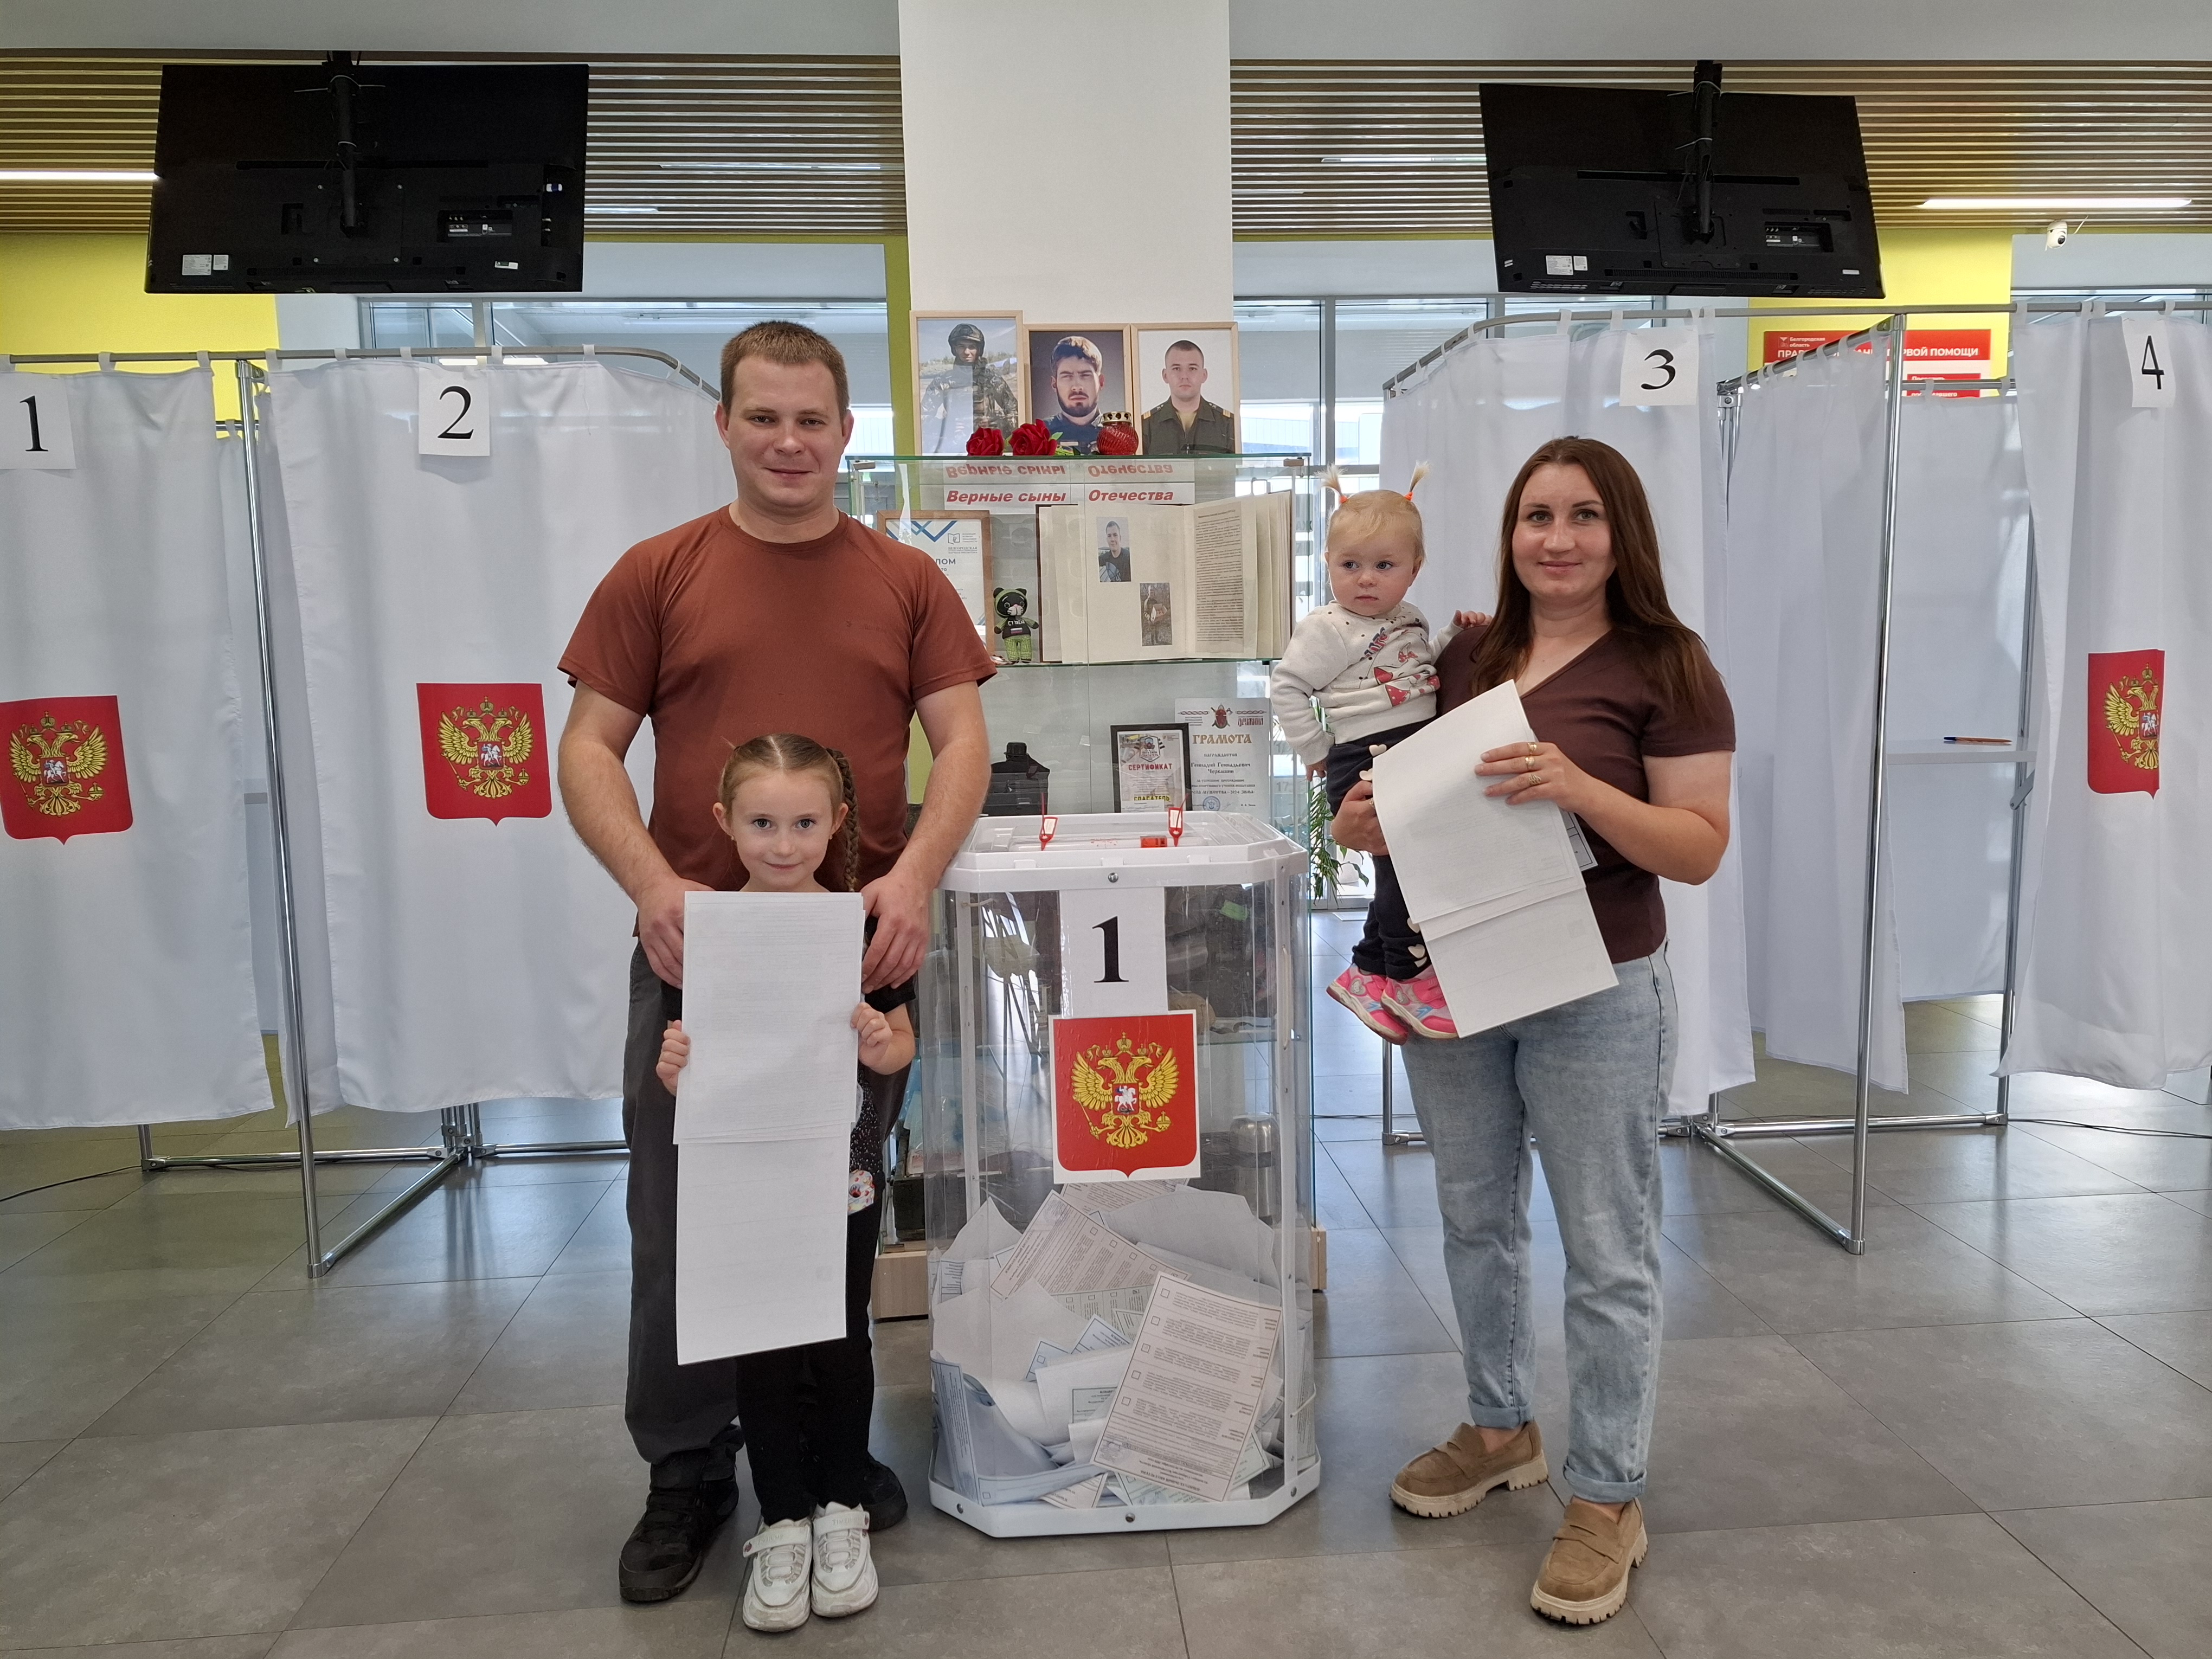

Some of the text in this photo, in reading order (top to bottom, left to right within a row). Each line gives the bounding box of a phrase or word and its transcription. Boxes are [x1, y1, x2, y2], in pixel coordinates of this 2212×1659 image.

[1640, 349, 1676, 390] 3
[1930, 348, 1979, 357] ПОМОЩИ
[2142, 336, 2165, 390] 4
[20, 395, 49, 452] 1
[438, 386, 474, 440] 2
[946, 489, 1174, 505] Верные сыны Отечества
[1192, 734, 1252, 744] ГРАМОТА
[1092, 916, 1129, 983] 1
